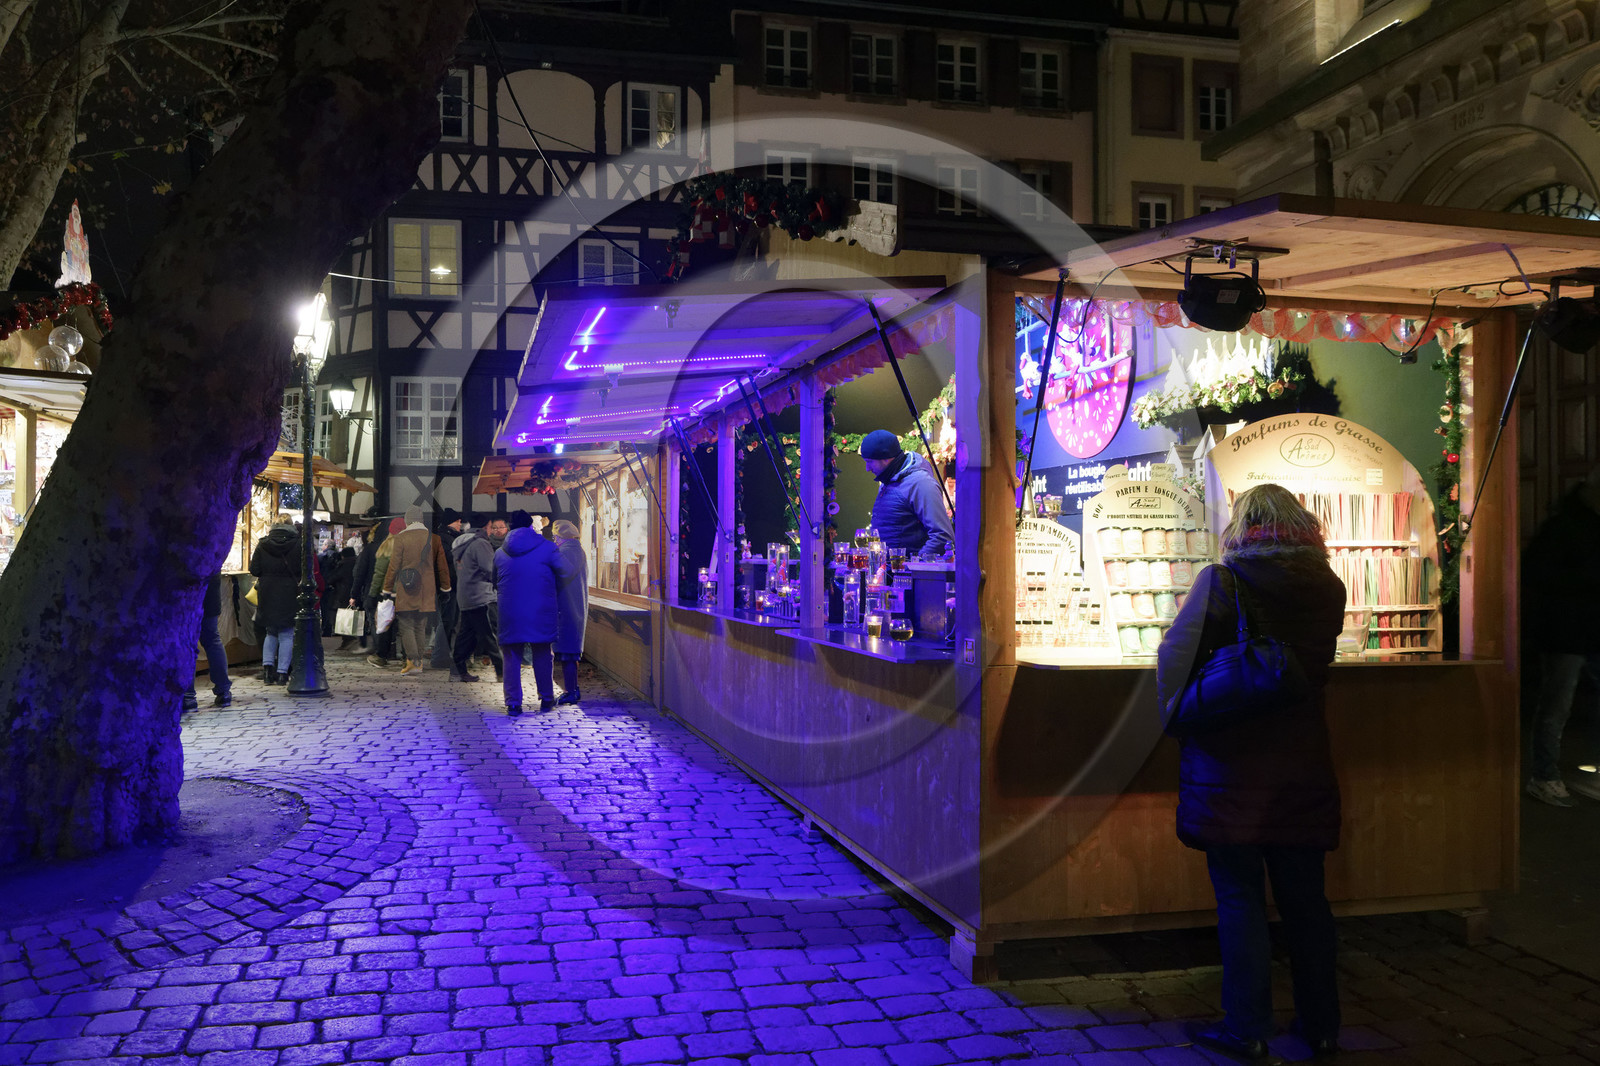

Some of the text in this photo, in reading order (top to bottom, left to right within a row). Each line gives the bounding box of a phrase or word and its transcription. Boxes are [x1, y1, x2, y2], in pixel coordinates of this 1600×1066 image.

[1231, 415, 1383, 454] Parfums de Grasse
[1068, 463, 1107, 480] La bougie
[1115, 485, 1141, 498] PARFUM
[1154, 485, 1178, 501] LONGUE
[1020, 521, 1038, 531] RFUM
